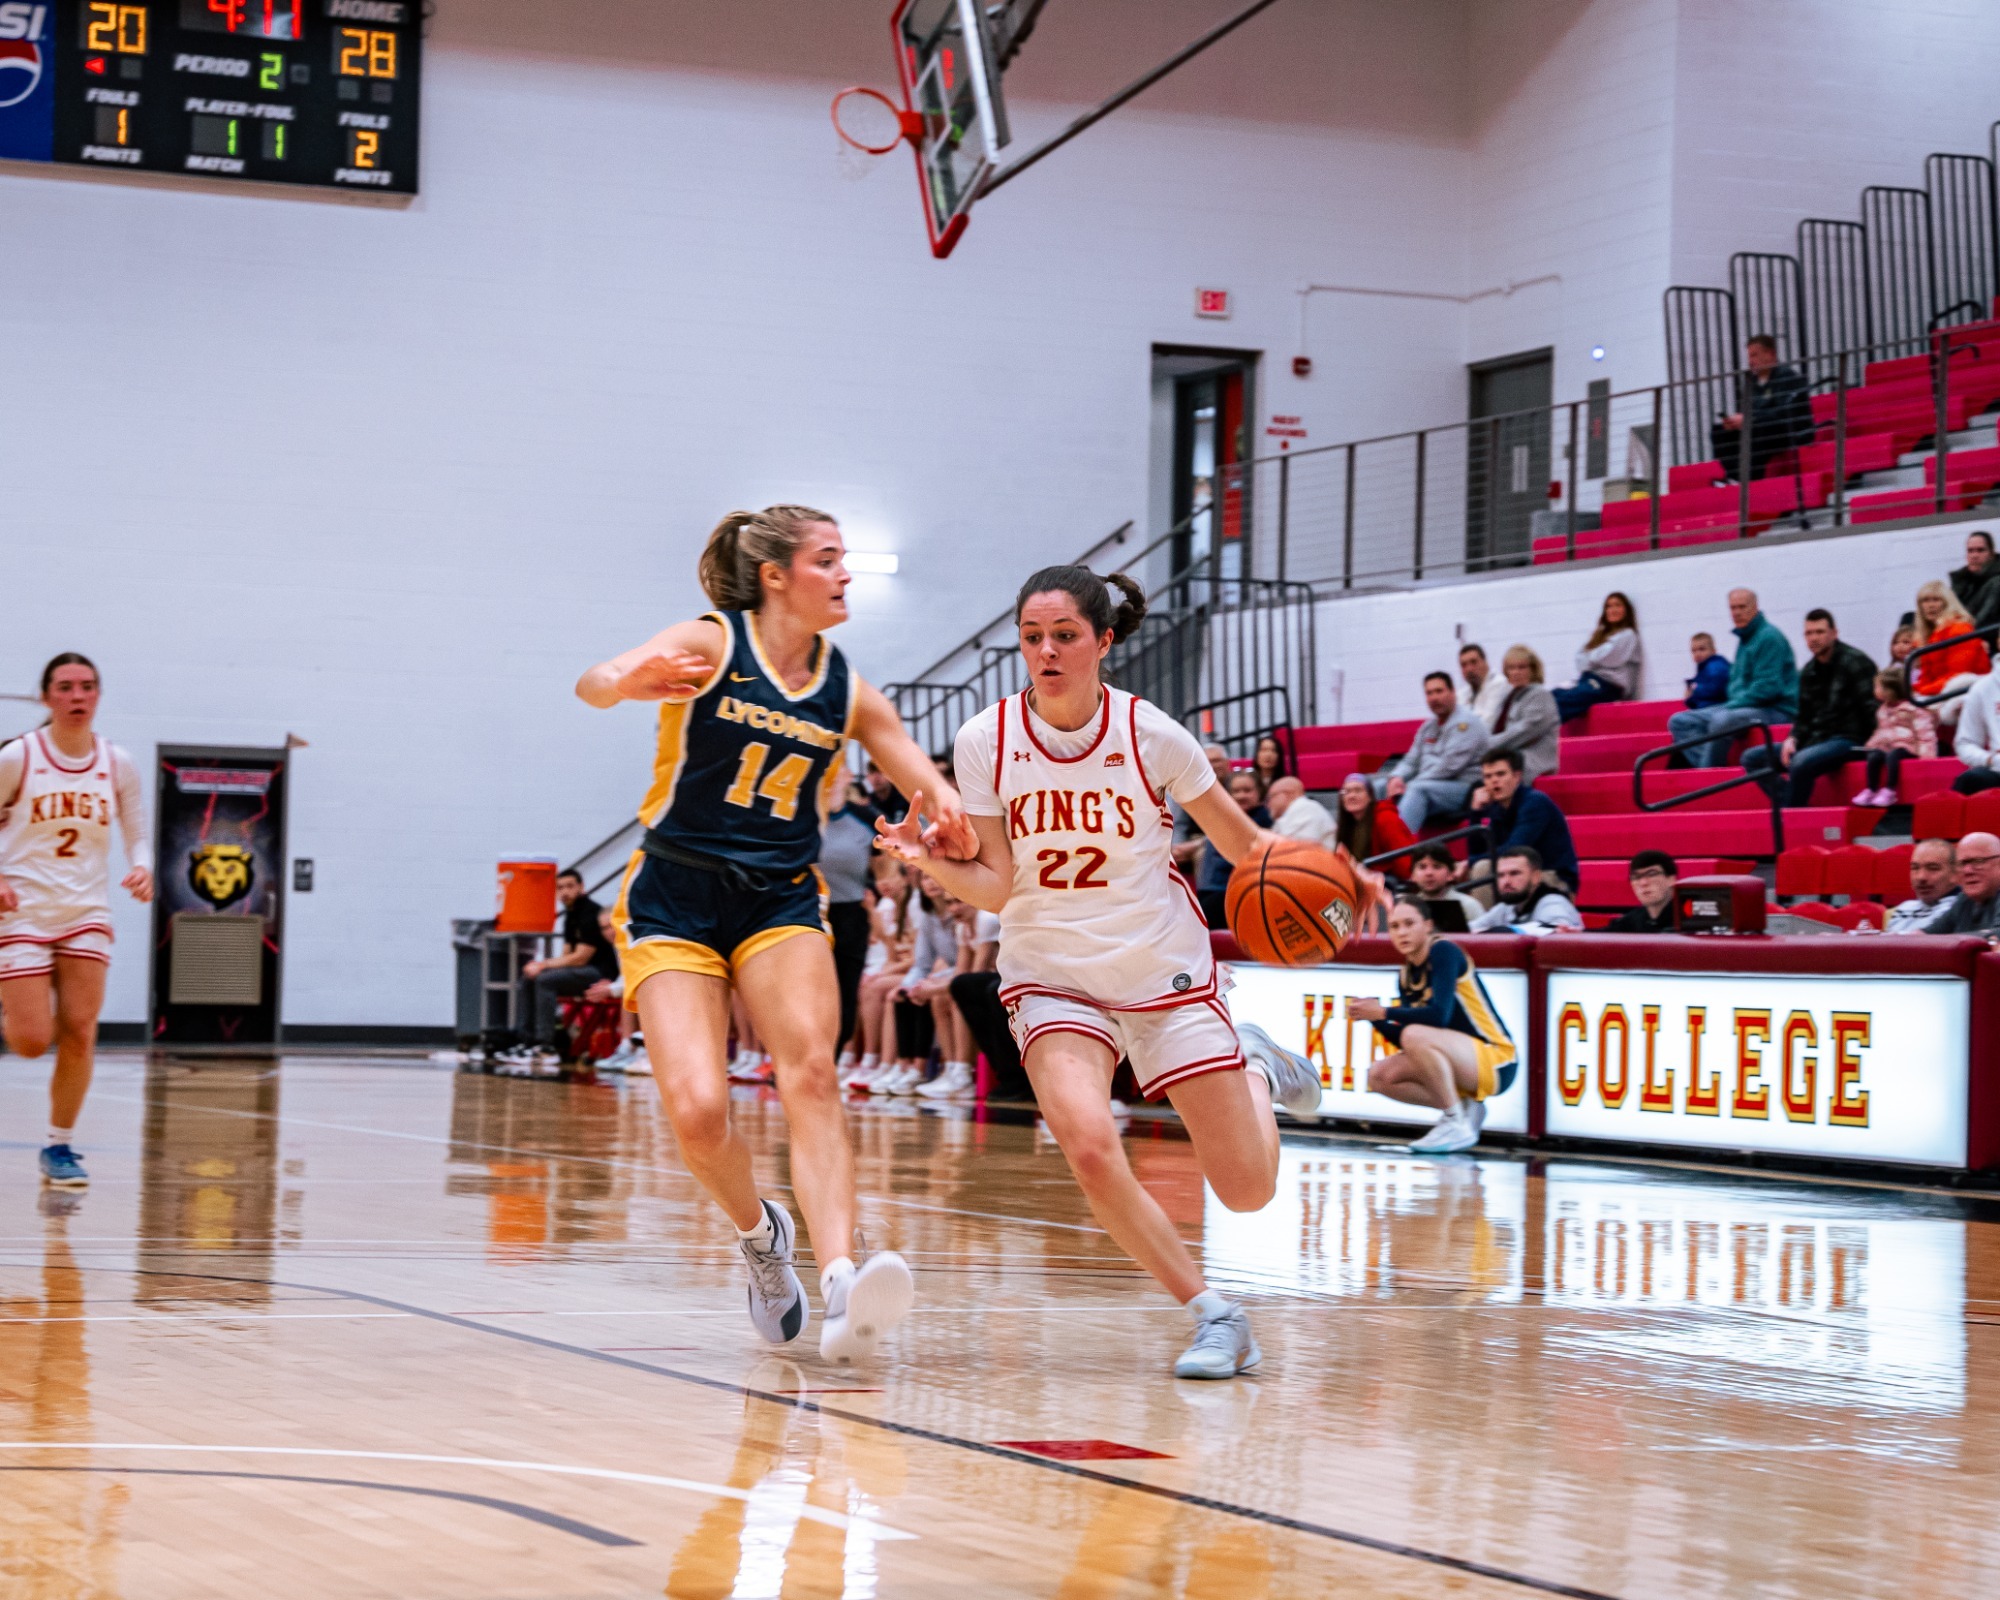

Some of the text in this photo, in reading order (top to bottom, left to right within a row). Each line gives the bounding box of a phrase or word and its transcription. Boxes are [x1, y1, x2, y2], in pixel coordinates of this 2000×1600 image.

[88, 2, 147, 54] 20
[328, 0, 404, 22] HOME
[340, 27, 397, 78] 28
[173, 53, 283, 89] PERIOD 2
[85, 88, 140, 106] FOULS
[184, 97, 296, 120] PLAYER-FOUL
[117, 108, 128, 145] 1
[228, 119, 238, 156] 1
[338, 111, 390, 130] FOULS
[81, 145, 142, 163] POINTS
[274, 124, 285, 160] 1
[355, 131, 379, 168] 2
[184, 155, 245, 173] MATCH
[334, 168, 393, 185] POINTS
[724, 741, 815, 821] 14
[30, 791, 109, 827] KING'S
[1009, 787, 1136, 841] KING'S
[55, 827, 79, 858] 2
[1036, 846, 1109, 890] 22
[1274, 910, 1312, 951] THE
[1557, 1001, 1872, 1128] COLLEGE
